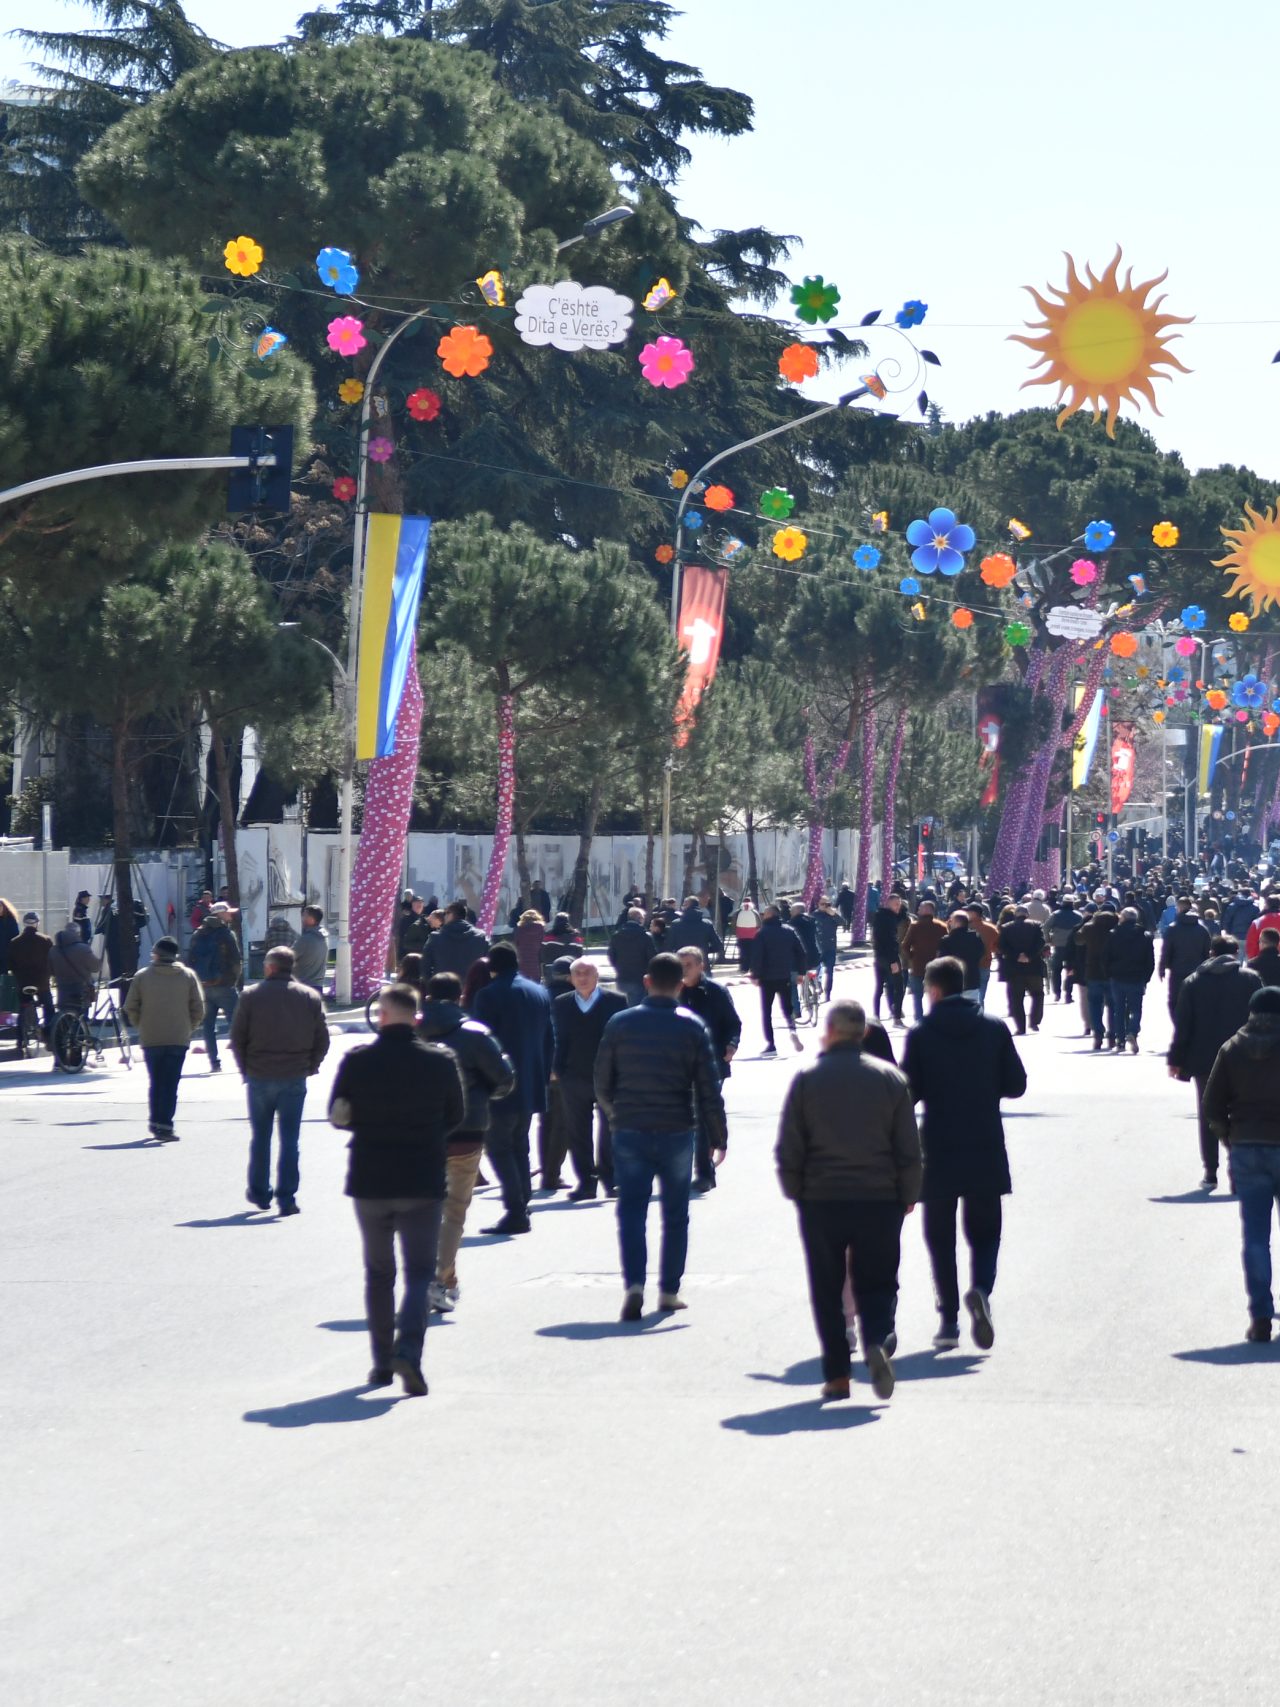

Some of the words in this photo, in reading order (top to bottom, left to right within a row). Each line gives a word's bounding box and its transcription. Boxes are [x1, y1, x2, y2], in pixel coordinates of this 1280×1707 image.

[548, 297, 599, 319] Ç'është
[528, 315, 555, 334] Dita
[559, 321, 568, 335] e
[572, 317, 618, 338] Verës?
